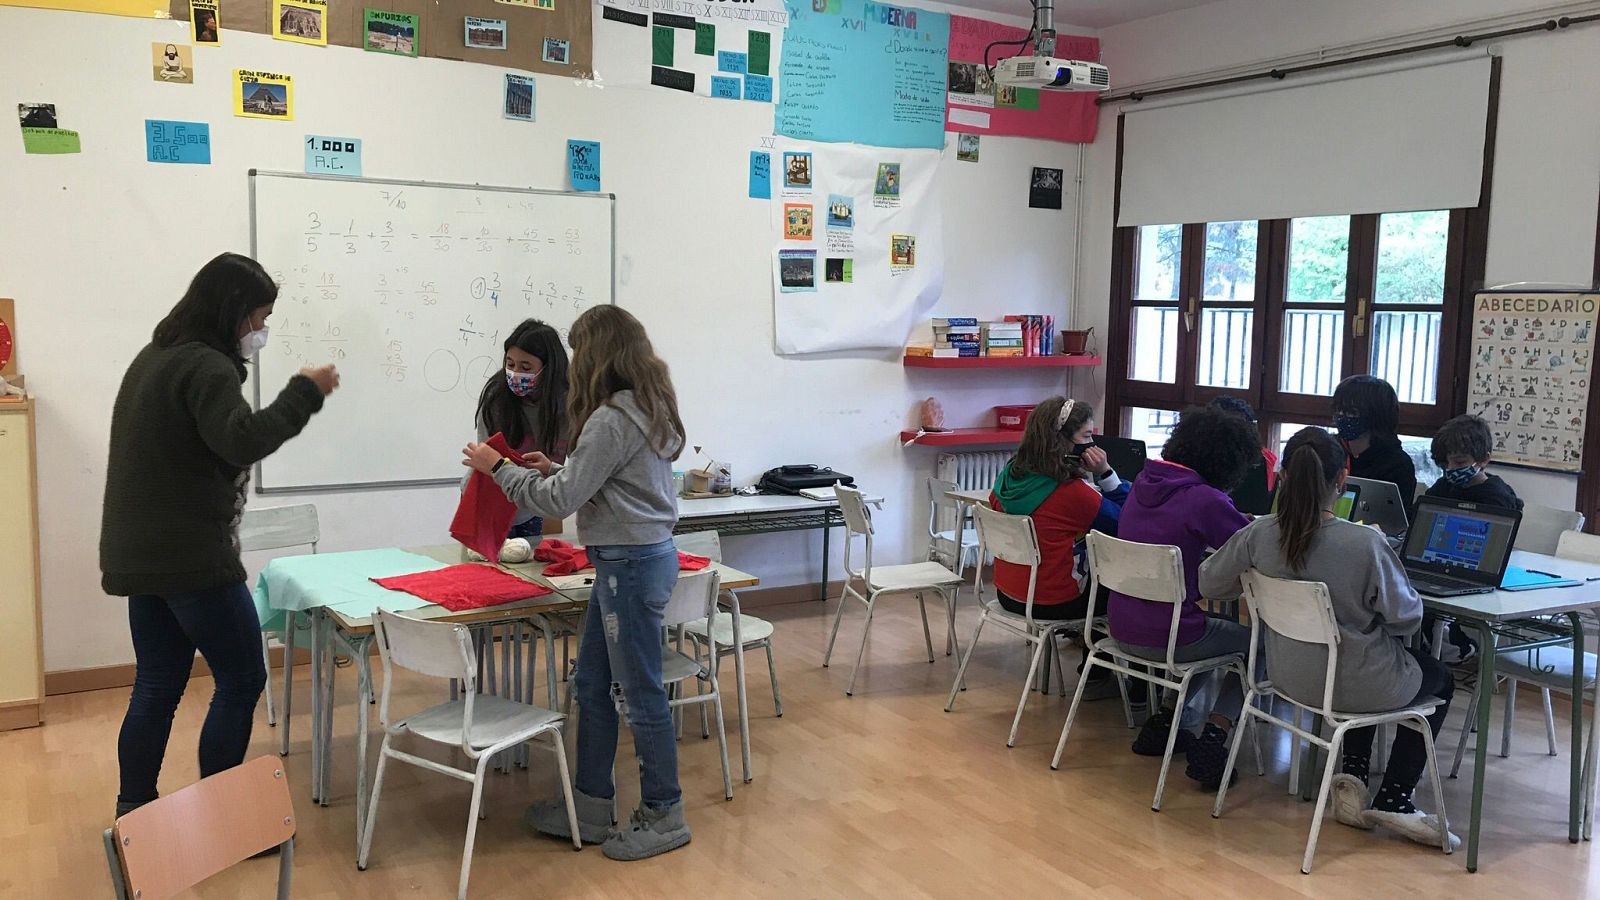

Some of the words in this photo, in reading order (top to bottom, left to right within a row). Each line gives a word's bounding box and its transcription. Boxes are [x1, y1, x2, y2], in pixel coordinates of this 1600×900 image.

[704, 4, 712, 18] X
[840, 18, 867, 32] XVII
[307, 137, 356, 153] 1.000
[315, 155, 344, 170] A.C.
[308, 211, 322, 230] 3
[385, 221, 394, 234] 3
[307, 236, 319, 253] 5
[345, 242, 358, 255] 3
[320, 271, 336, 285] 18
[376, 273, 389, 287] 3
[492, 271, 502, 289] 3
[320, 288, 339, 301] 30
[489, 289, 499, 310] 4
[1479, 298, 1595, 313] ABECEDARIO
[1488, 318, 1496, 327] A
[1512, 318, 1520, 328] B
[1559, 319, 1568, 329] D
[1585, 320, 1592, 329] E
[280, 339, 294, 356] 3
[1509, 346, 1517, 355] G
[1533, 347, 1541, 357] H
[1486, 373, 1493, 382] K
[1529, 376, 1539, 386] M
[1578, 379, 1587, 389] O
[1505, 402, 1513, 412] Q
[1553, 406, 1562, 415] S
[1497, 409, 1511, 422] 15
[1504, 431, 1512, 440] V
[1526, 432, 1537, 443] W
[1551, 435, 1559, 445] X
